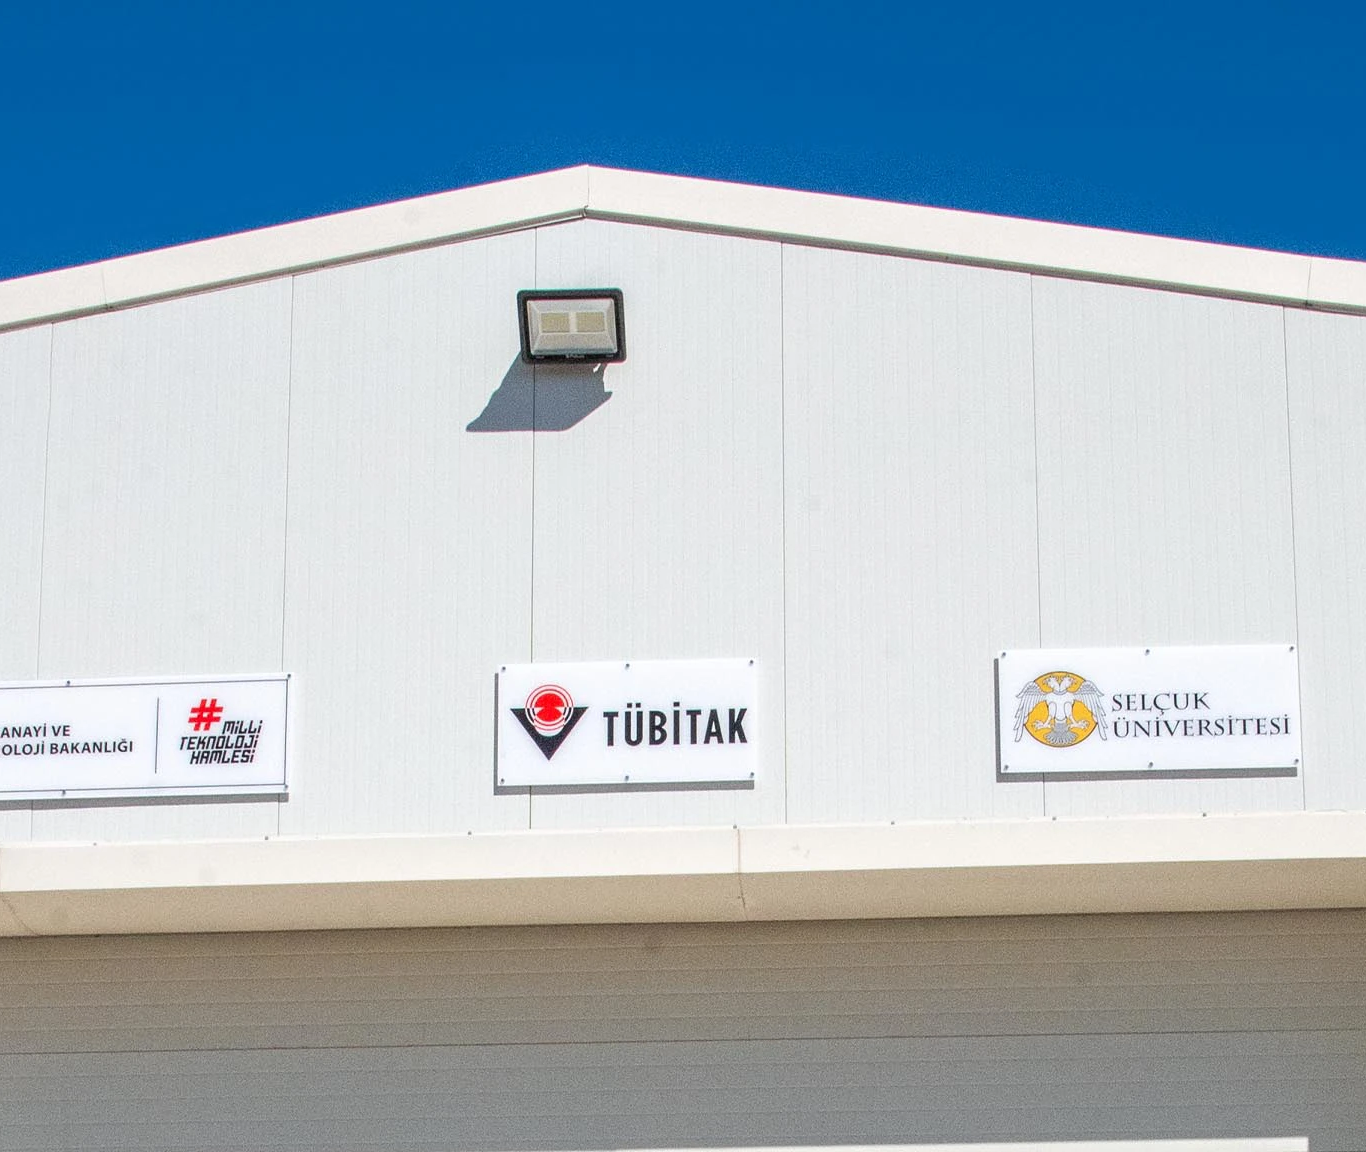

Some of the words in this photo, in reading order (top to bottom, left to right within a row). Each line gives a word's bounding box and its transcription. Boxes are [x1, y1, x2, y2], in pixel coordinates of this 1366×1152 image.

[1111, 691, 1211, 715] SELÇUK
[51, 724, 71, 737] VE
[602, 701, 748, 747] TÜBİTAK
[1112, 714, 1291, 738] ÜNİVERSİTESİ
[49, 738, 134, 755] BAKANLIĞI
